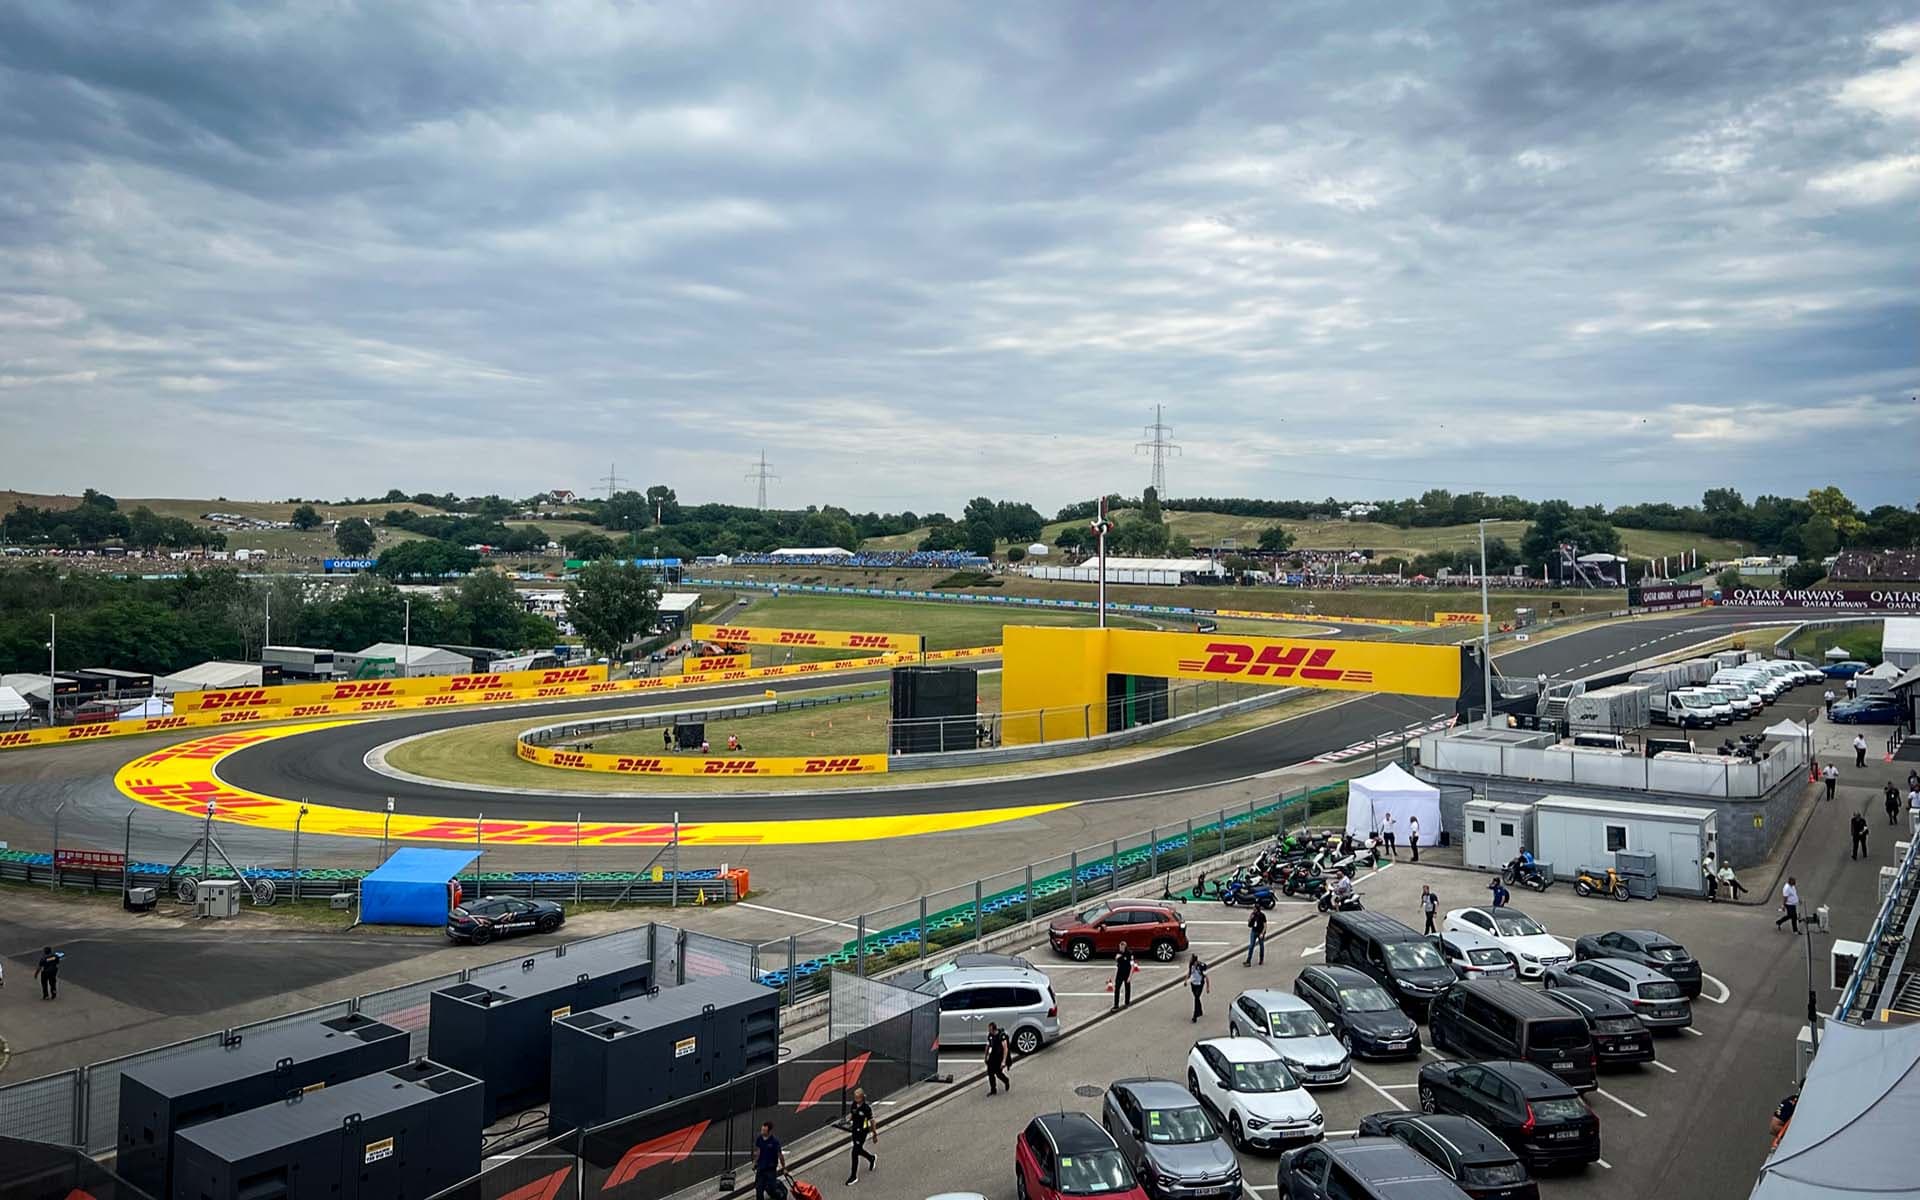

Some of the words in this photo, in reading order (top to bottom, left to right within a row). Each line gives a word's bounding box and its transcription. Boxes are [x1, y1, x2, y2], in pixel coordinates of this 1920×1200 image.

[334, 560, 371, 568] aramco
[1733, 590, 1780, 602] QATAR
[1783, 590, 1844, 601] AIRWAYS
[1871, 591, 1920, 602] QATAR
[1751, 599, 1785, 607] AIRWAYS
[1447, 614, 1478, 622] DHL
[715, 628, 752, 641] DHL
[779, 632, 818, 645] DHL
[848, 635, 890, 649] DHL
[699, 657, 737, 671] DHL
[1203, 642, 1344, 682] DHL
[543, 669, 590, 684] DHL
[724, 671, 746, 680] DHL
[763, 668, 784, 676] DHL
[449, 675, 503, 691] DHL
[591, 683, 617, 692] DHL
[639, 679, 663, 688] DHL
[333, 682, 395, 700] DHL
[484, 691, 514, 701] DHL
[538, 687, 566, 697] DHL
[201, 690, 269, 710] DHL
[361, 700, 397, 711] DHL
[425, 695, 457, 706] DHL
[220, 711, 261, 723] DHL
[292, 706, 332, 717] DHL
[145, 716, 188, 730] DHL
[68, 725, 111, 739] DHL
[0, 733, 32, 746] HL
[521, 746, 537, 760] DHL
[553, 753, 586, 768] DHL
[617, 759, 664, 772] DHL
[805, 759, 864, 773] DHL
[703, 761, 759, 774] DHL
